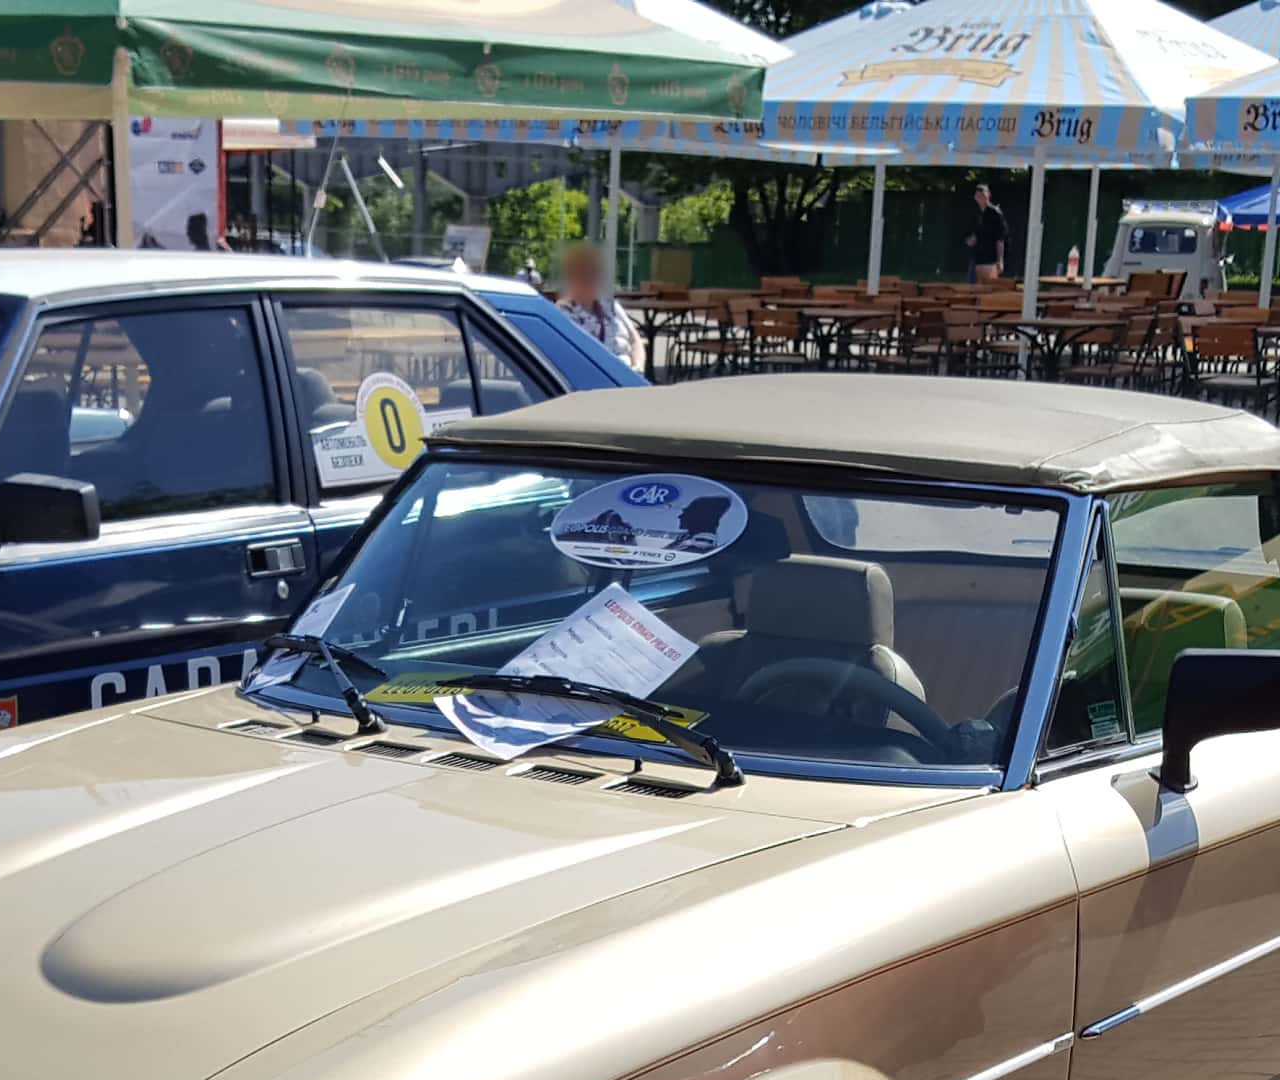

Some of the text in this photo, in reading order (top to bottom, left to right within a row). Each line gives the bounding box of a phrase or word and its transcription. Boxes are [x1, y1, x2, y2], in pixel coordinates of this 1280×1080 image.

[776, 115, 1018, 133] ЧОЛОВІЧІ БЕЛЬГІЙСЬКІ ЛАСОЩІ
[1031, 110, 1093, 144] Brug
[629, 486, 669, 504] CAR
